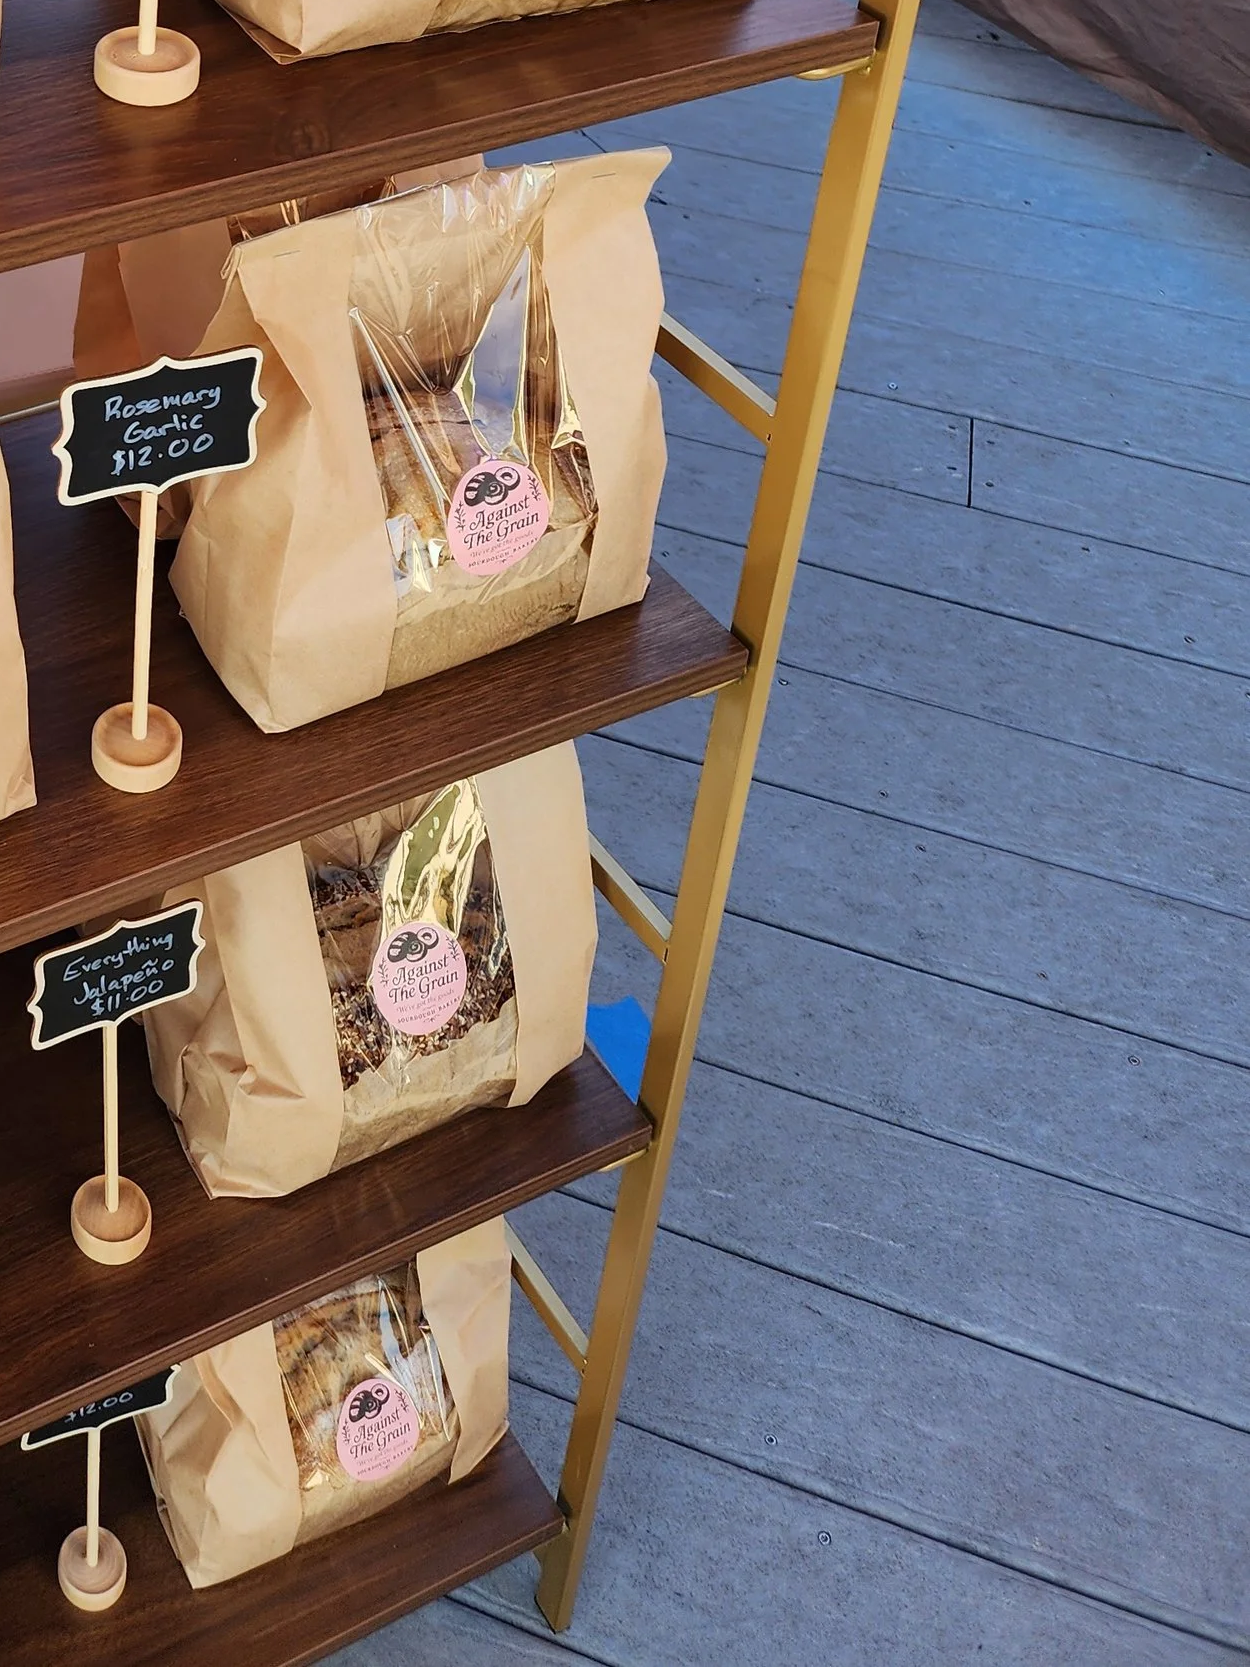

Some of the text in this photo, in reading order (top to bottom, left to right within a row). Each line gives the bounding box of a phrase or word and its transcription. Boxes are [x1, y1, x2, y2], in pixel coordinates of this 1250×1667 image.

[104, 385, 221, 422] Rosemary
[123, 413, 204, 444] Garlic
[111, 433, 214, 476] $12.00
[463, 530, 493, 550] The
[496, 512, 539, 542] Grain
[469, 495, 530, 530] Against
[63, 933, 174, 982] Everything
[392, 954, 449, 986] Against
[73, 957, 175, 1005] Jalapeño
[90, 979, 164, 1017] $11.00
[388, 985, 416, 1004] The
[419, 970, 458, 999] Grain
[350, 1440, 374, 1460] The
[376, 1422, 411, 1452] Grain
[353, 1407, 400, 1443] Against
